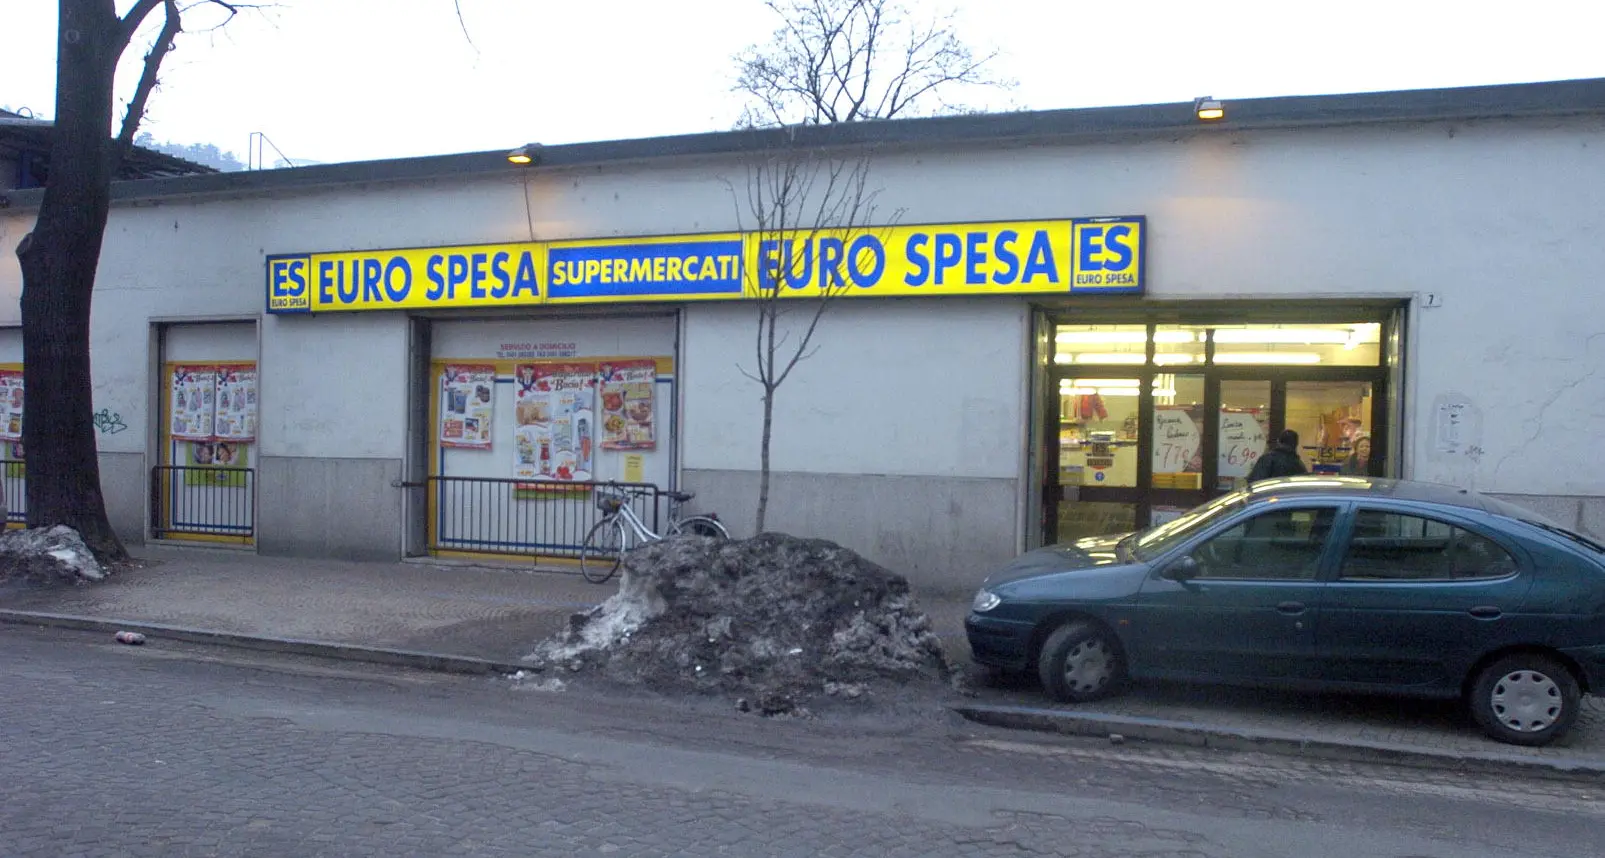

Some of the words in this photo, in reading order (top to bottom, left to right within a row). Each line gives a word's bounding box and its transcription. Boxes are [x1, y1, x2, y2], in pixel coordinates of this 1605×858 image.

[759, 234, 885, 289] EURO
[904, 231, 1058, 288] SPESA
[1080, 225, 1133, 272] ES
[273, 260, 306, 297] ES
[319, 256, 412, 304] EURO
[426, 247, 539, 300] SPESA
[553, 256, 739, 286] SUPERMERCATI
[1077, 274, 1102, 284] EURO
[1106, 273, 1135, 284] SPESA
[272, 299, 287, 308] EURO
[289, 298, 307, 307] SPESA
[539, 342, 576, 350] DOMICILIO
